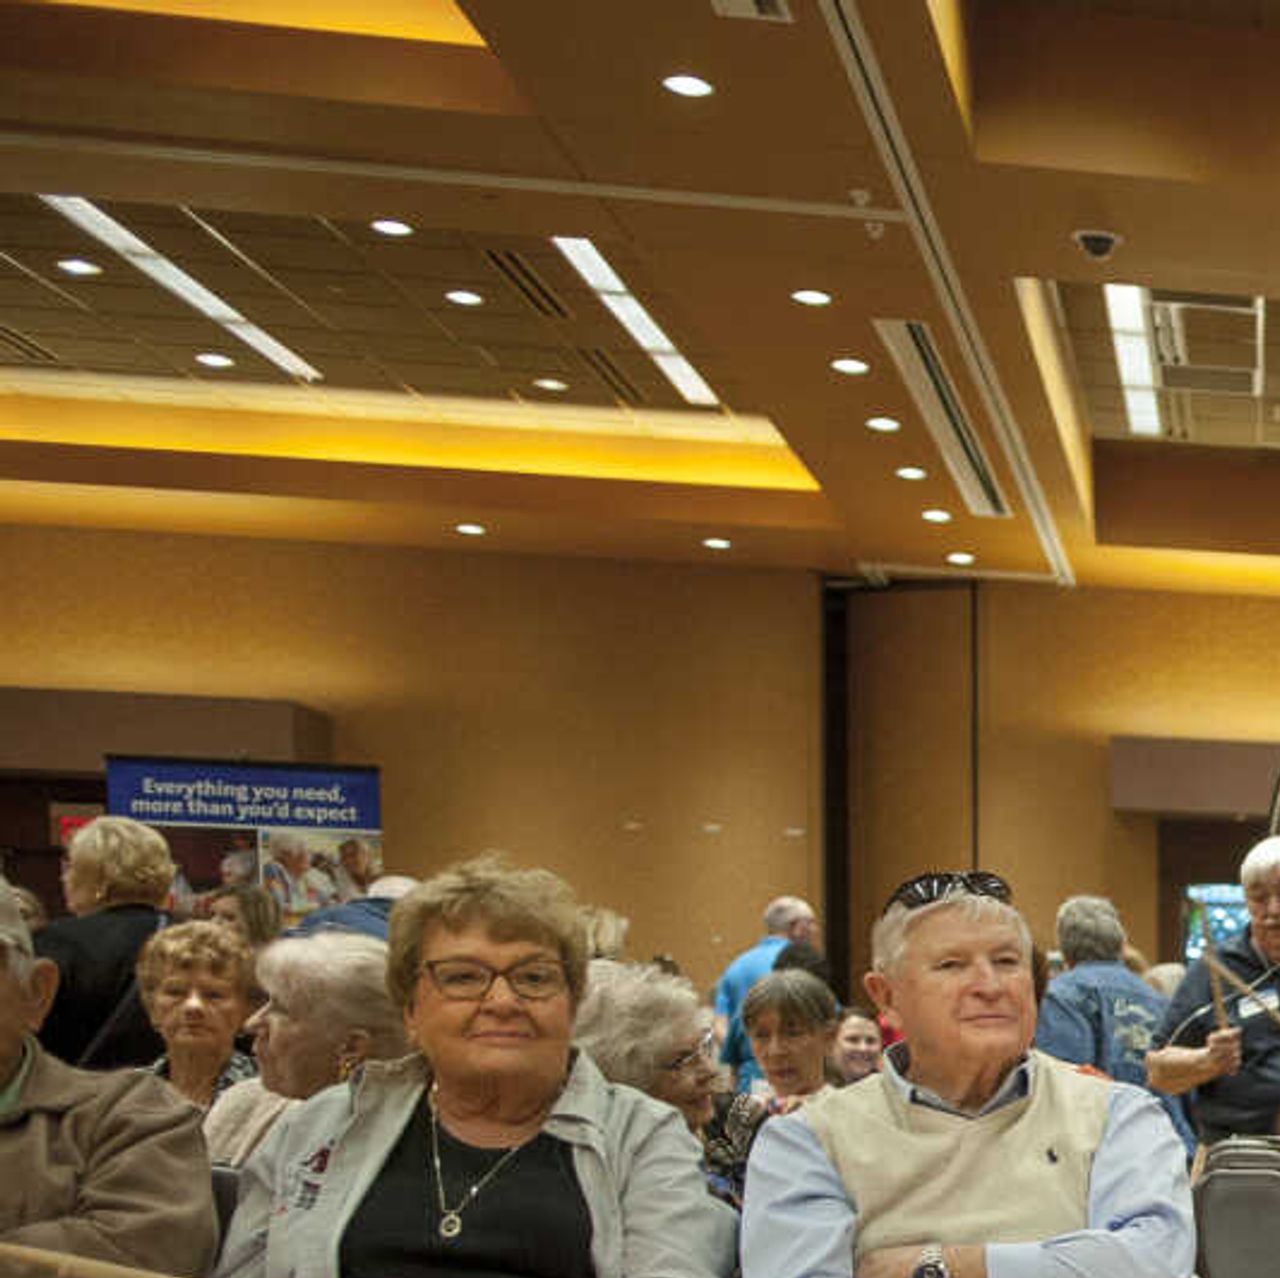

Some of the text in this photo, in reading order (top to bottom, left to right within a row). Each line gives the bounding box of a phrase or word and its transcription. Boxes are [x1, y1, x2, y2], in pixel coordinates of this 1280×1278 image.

[142, 777, 347, 804] Everything you need,
[131, 798, 358, 823] more than you'd expect
